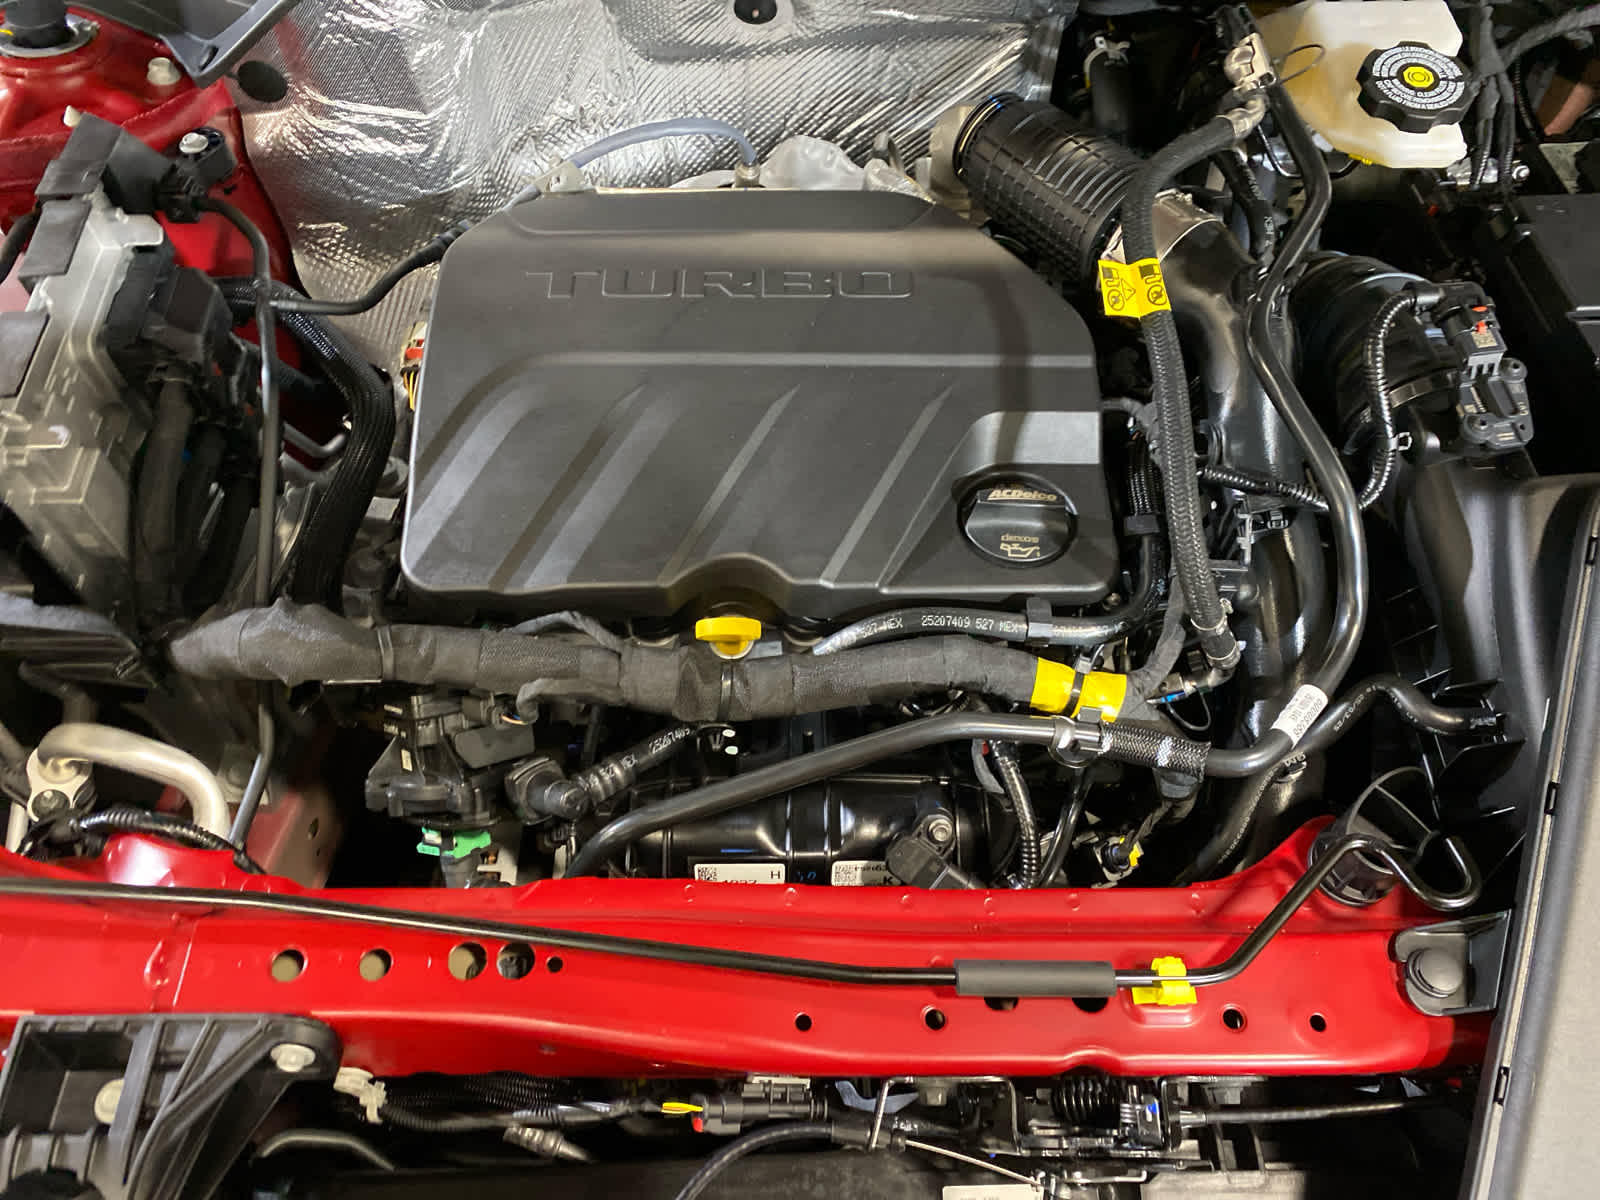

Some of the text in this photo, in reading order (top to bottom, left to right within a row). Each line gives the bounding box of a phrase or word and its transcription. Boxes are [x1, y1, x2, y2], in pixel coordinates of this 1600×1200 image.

[525, 268, 912, 299] TURBO
[988, 489, 1057, 501] ACDelco
[921, 614, 971, 628] 25207409
[975, 616, 995, 630] 527
[999, 619, 1019, 634] MEX
[770, 871, 781, 879] H
[883, 876, 893, 885] K
